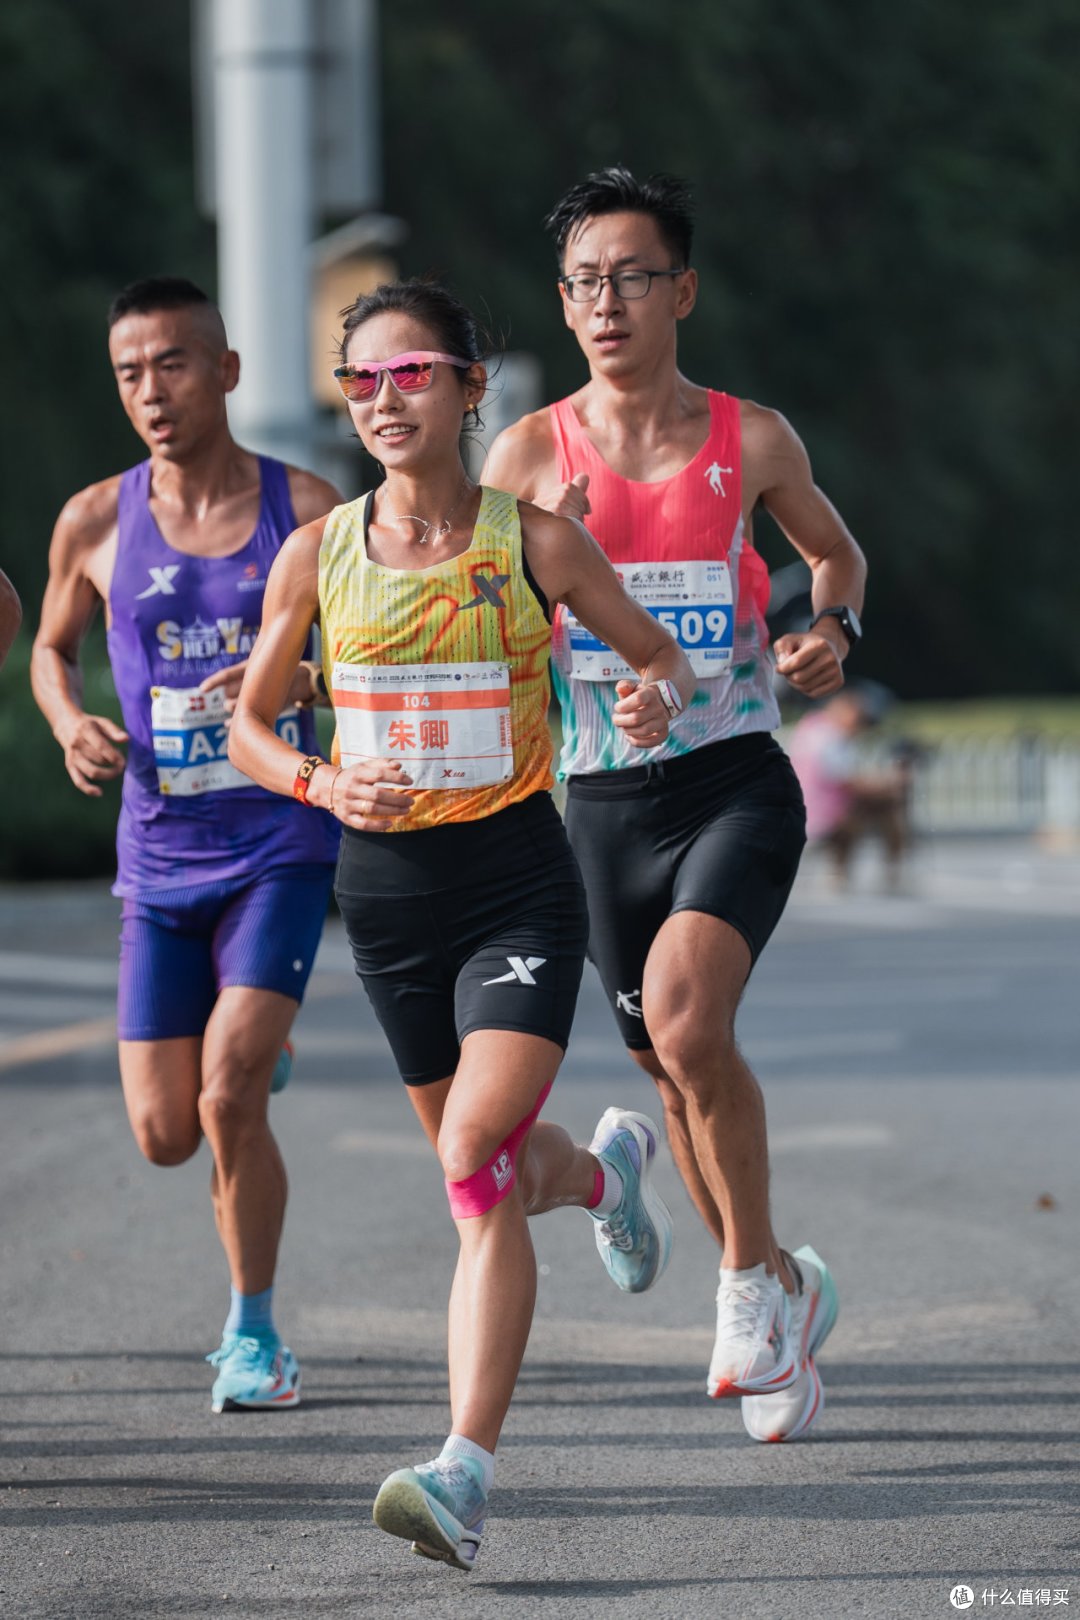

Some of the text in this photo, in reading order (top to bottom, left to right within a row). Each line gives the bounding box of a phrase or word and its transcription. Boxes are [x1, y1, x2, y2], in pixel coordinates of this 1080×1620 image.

[707, 574, 721, 582] 051
[403, 695, 431, 708] 104
[388, 719, 449, 751] 朱卿
[492, 1155, 508, 1180] LP
